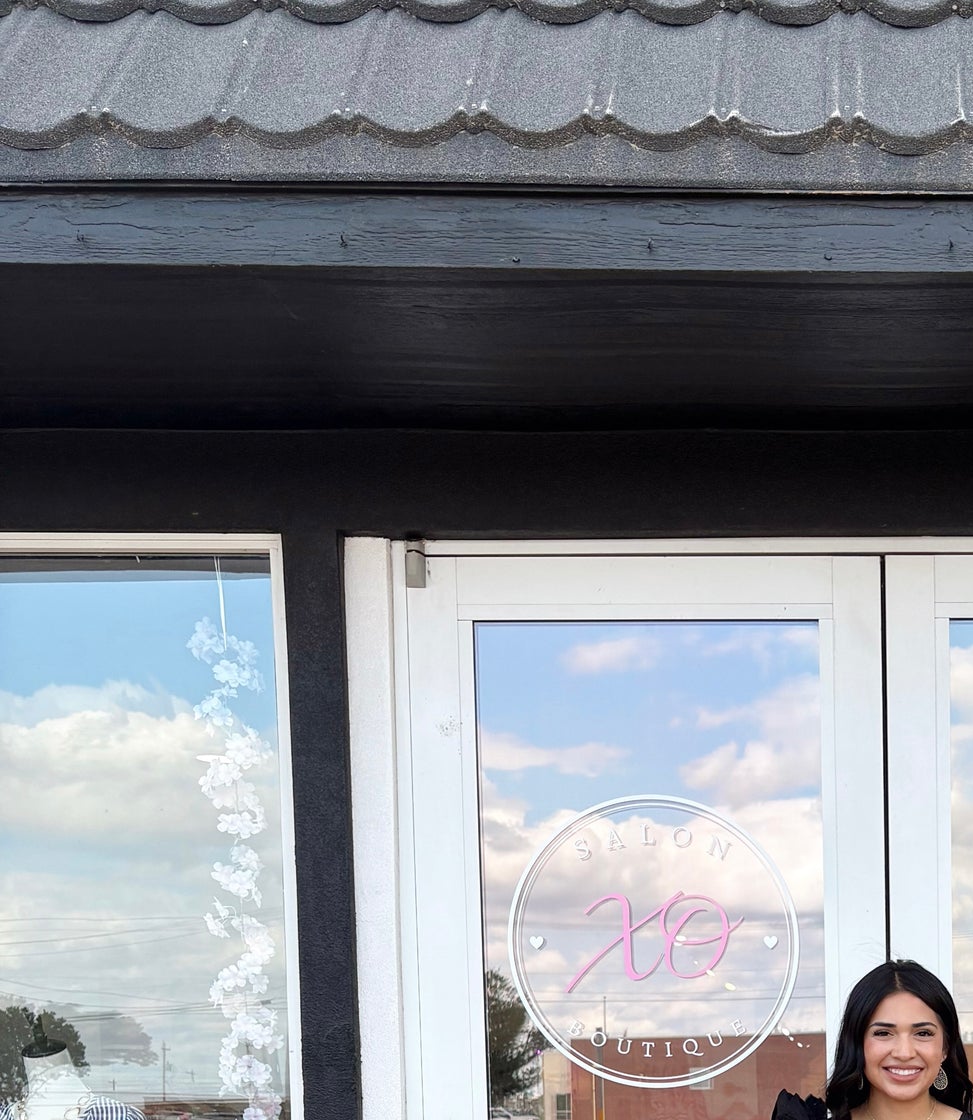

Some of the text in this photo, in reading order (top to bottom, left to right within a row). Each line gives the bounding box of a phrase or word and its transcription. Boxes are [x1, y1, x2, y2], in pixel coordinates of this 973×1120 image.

[574, 823, 732, 861] SALON
[565, 890, 745, 994] XO
[567, 1018, 747, 1057] BOUTIQUE
